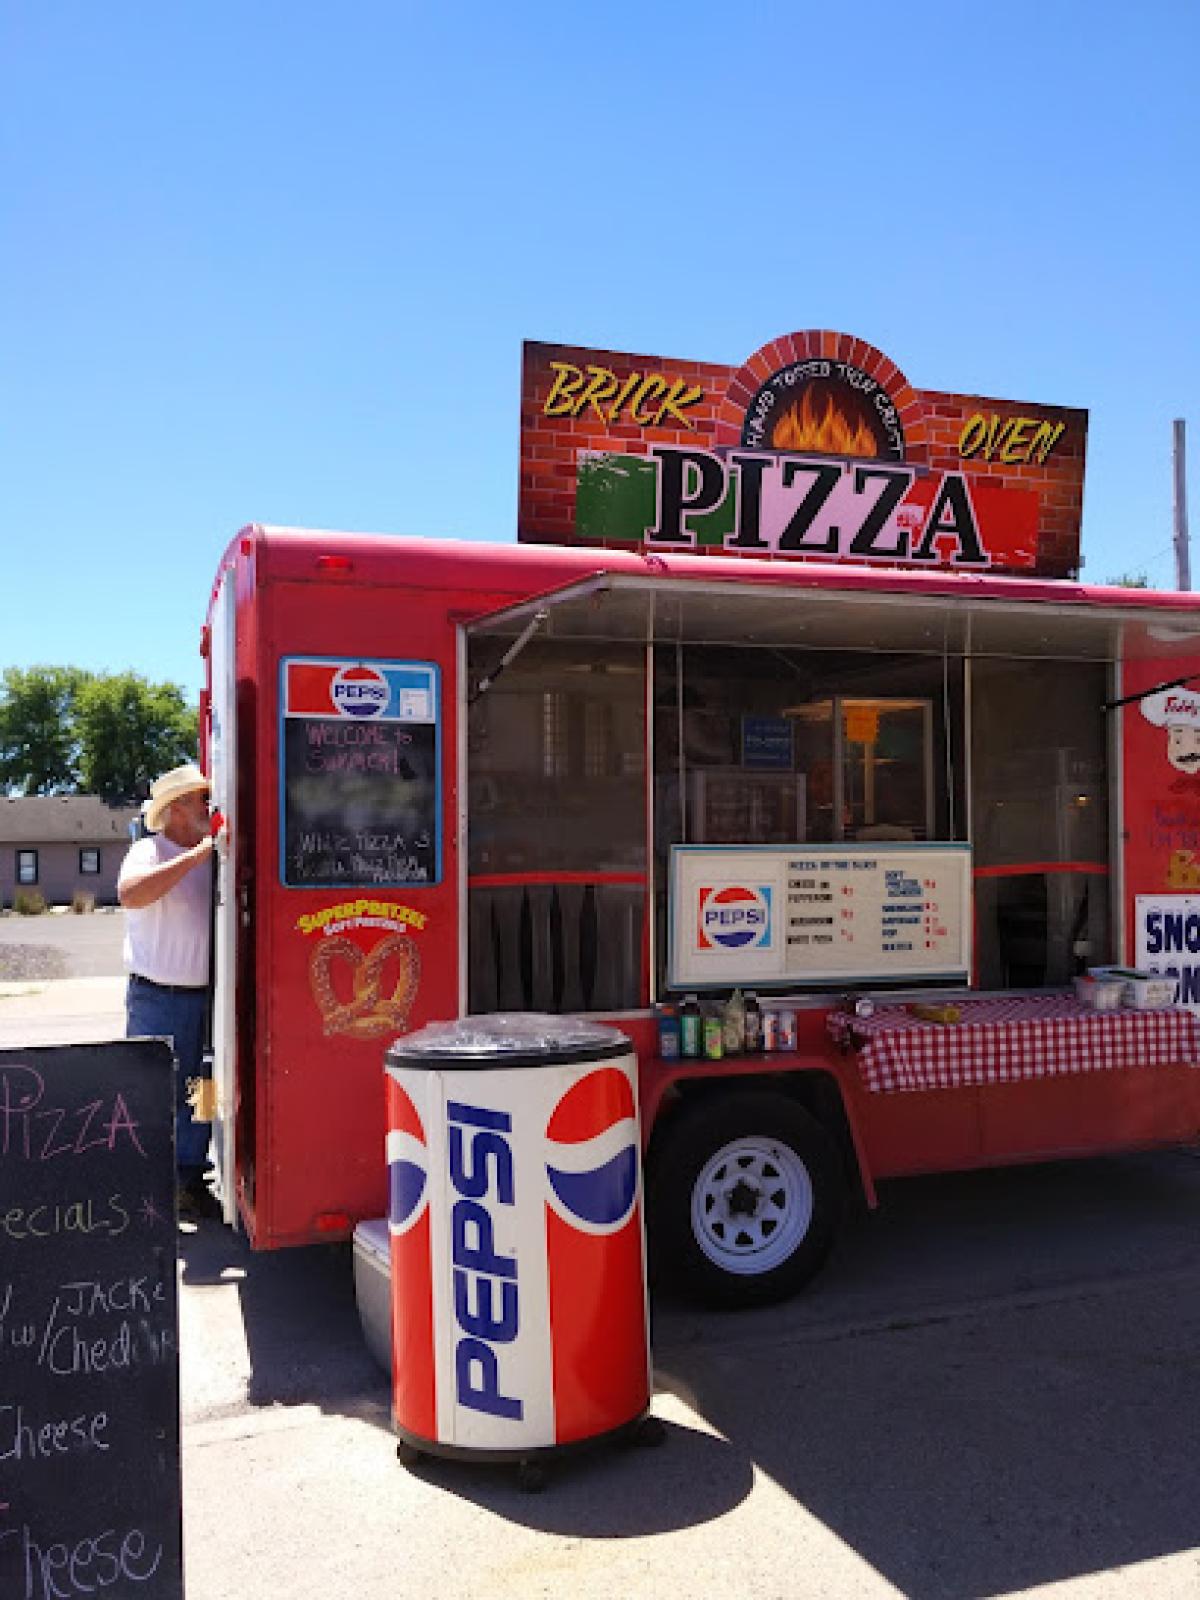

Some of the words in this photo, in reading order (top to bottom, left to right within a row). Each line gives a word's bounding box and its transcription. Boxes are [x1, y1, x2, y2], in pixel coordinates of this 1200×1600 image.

[540, 362, 702, 429] BRICK
[745, 389, 776, 447] HAND
[957, 410, 1065, 465] OVEN
[646, 445, 990, 566] PIZZA
[334, 684, 388, 700] PEPSI
[705, 908, 766, 926] PEPSI
[1146, 911, 1200, 954] SNO
[446, 1099, 524, 1422] PEPSI
